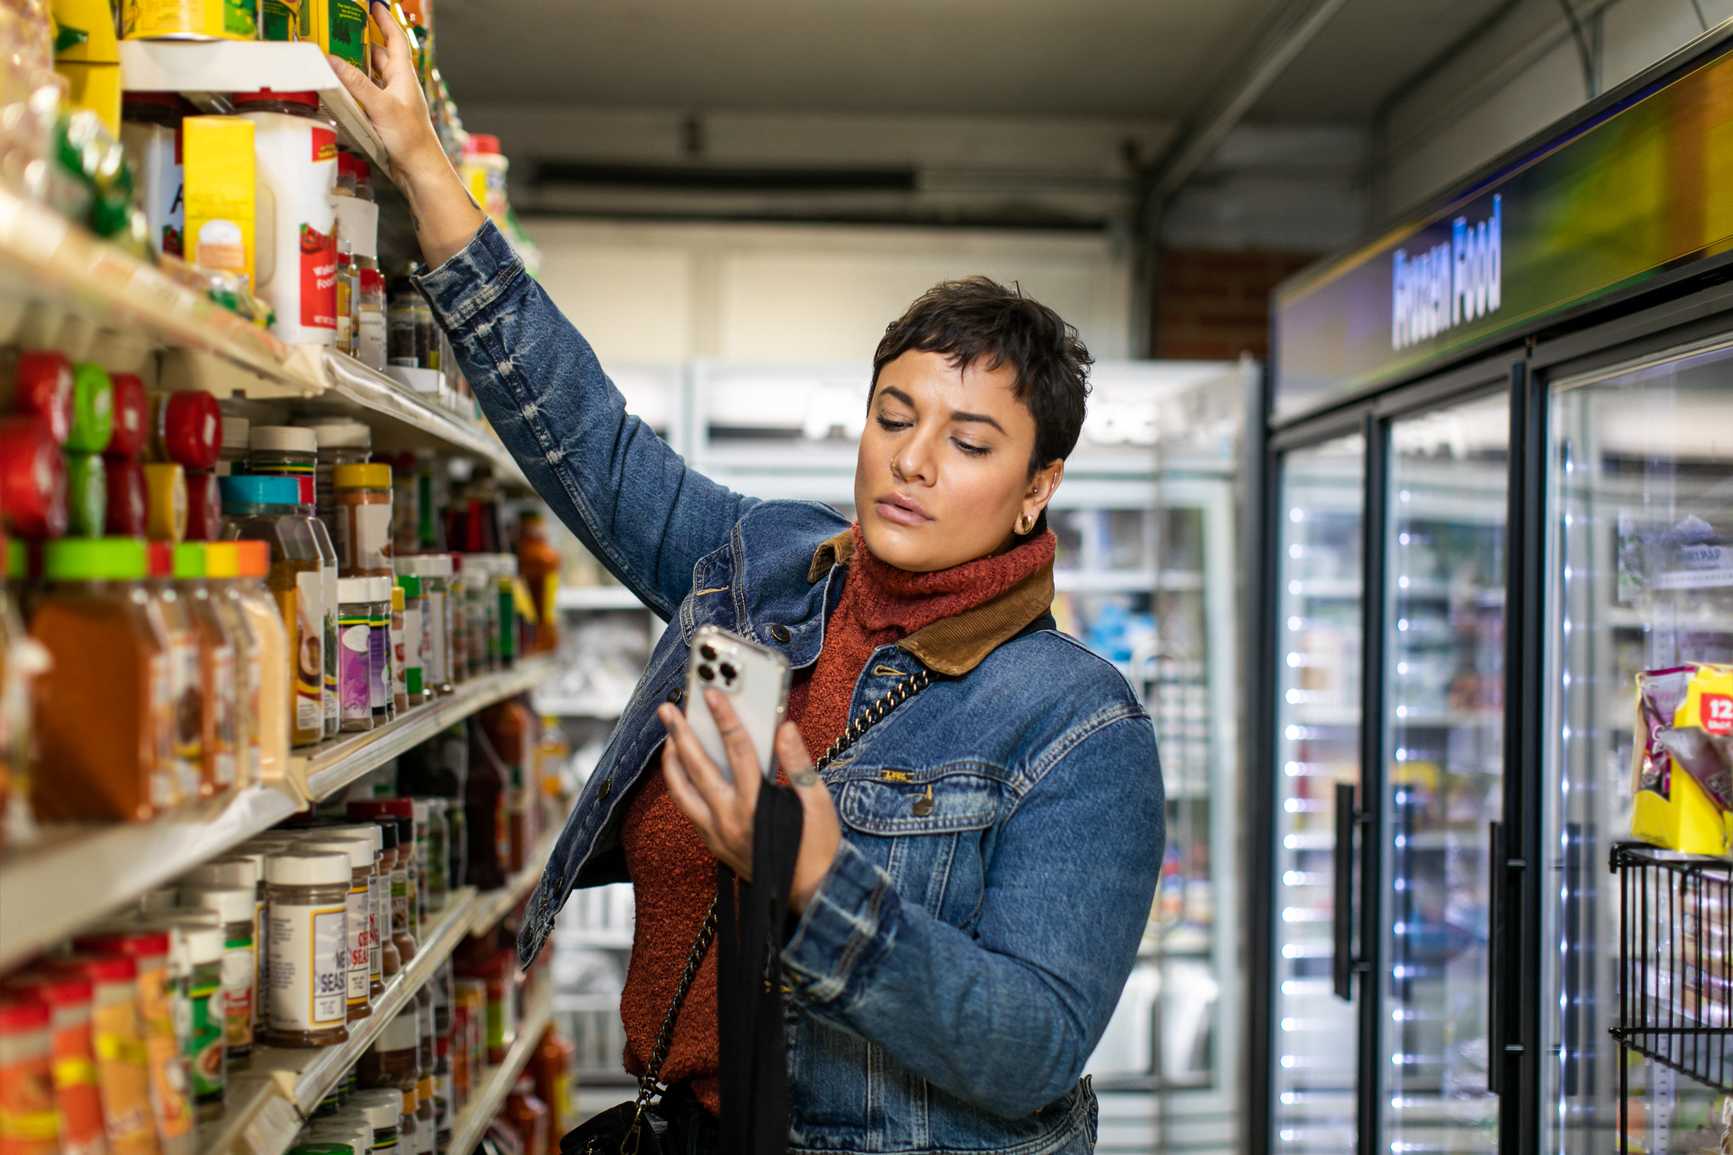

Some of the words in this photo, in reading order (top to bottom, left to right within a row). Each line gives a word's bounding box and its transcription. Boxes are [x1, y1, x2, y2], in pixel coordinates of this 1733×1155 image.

[1391, 248, 1450, 350] Frozen
[1452, 193, 1501, 326] Food
[1709, 699, 1733, 721] 12
